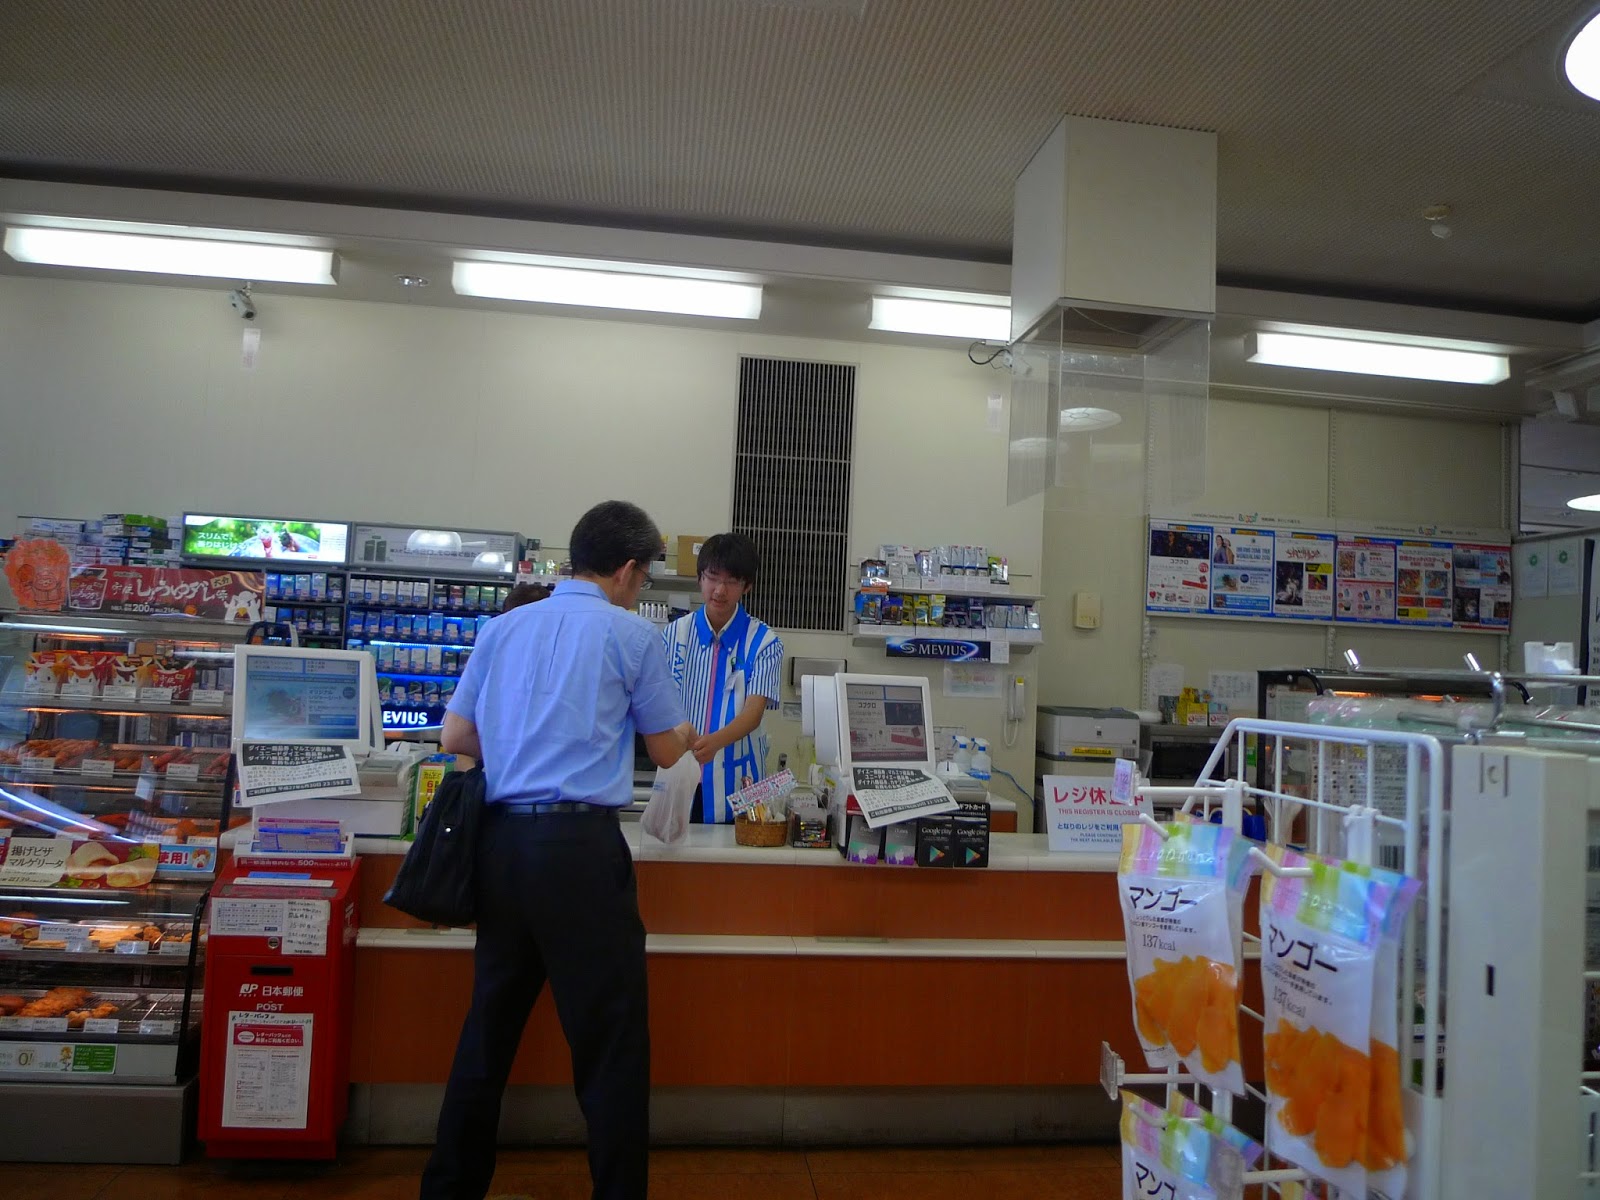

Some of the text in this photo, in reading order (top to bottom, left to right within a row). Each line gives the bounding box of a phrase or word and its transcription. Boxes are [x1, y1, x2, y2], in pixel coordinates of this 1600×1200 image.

[918, 643, 968, 656] MEVIUS
[382, 710, 428, 726] EVIUS
[921, 826, 940, 836] Google
[957, 828, 976, 837] Google
[1057, 823, 1121, 832] となりのレジをご利用
[11, 845, 54, 857] 揚げピザ
[9, 858, 64, 868] マルゲリータ
[1129, 885, 1198, 912] マンゴー
[1142, 933, 1176, 951] 137kcal
[1269, 924, 1338, 972] マンゴー
[262, 985, 304, 997] 日本郵便
[256, 1003, 284, 1011] POST
[1135, 1161, 1177, 1200] マンゴ
